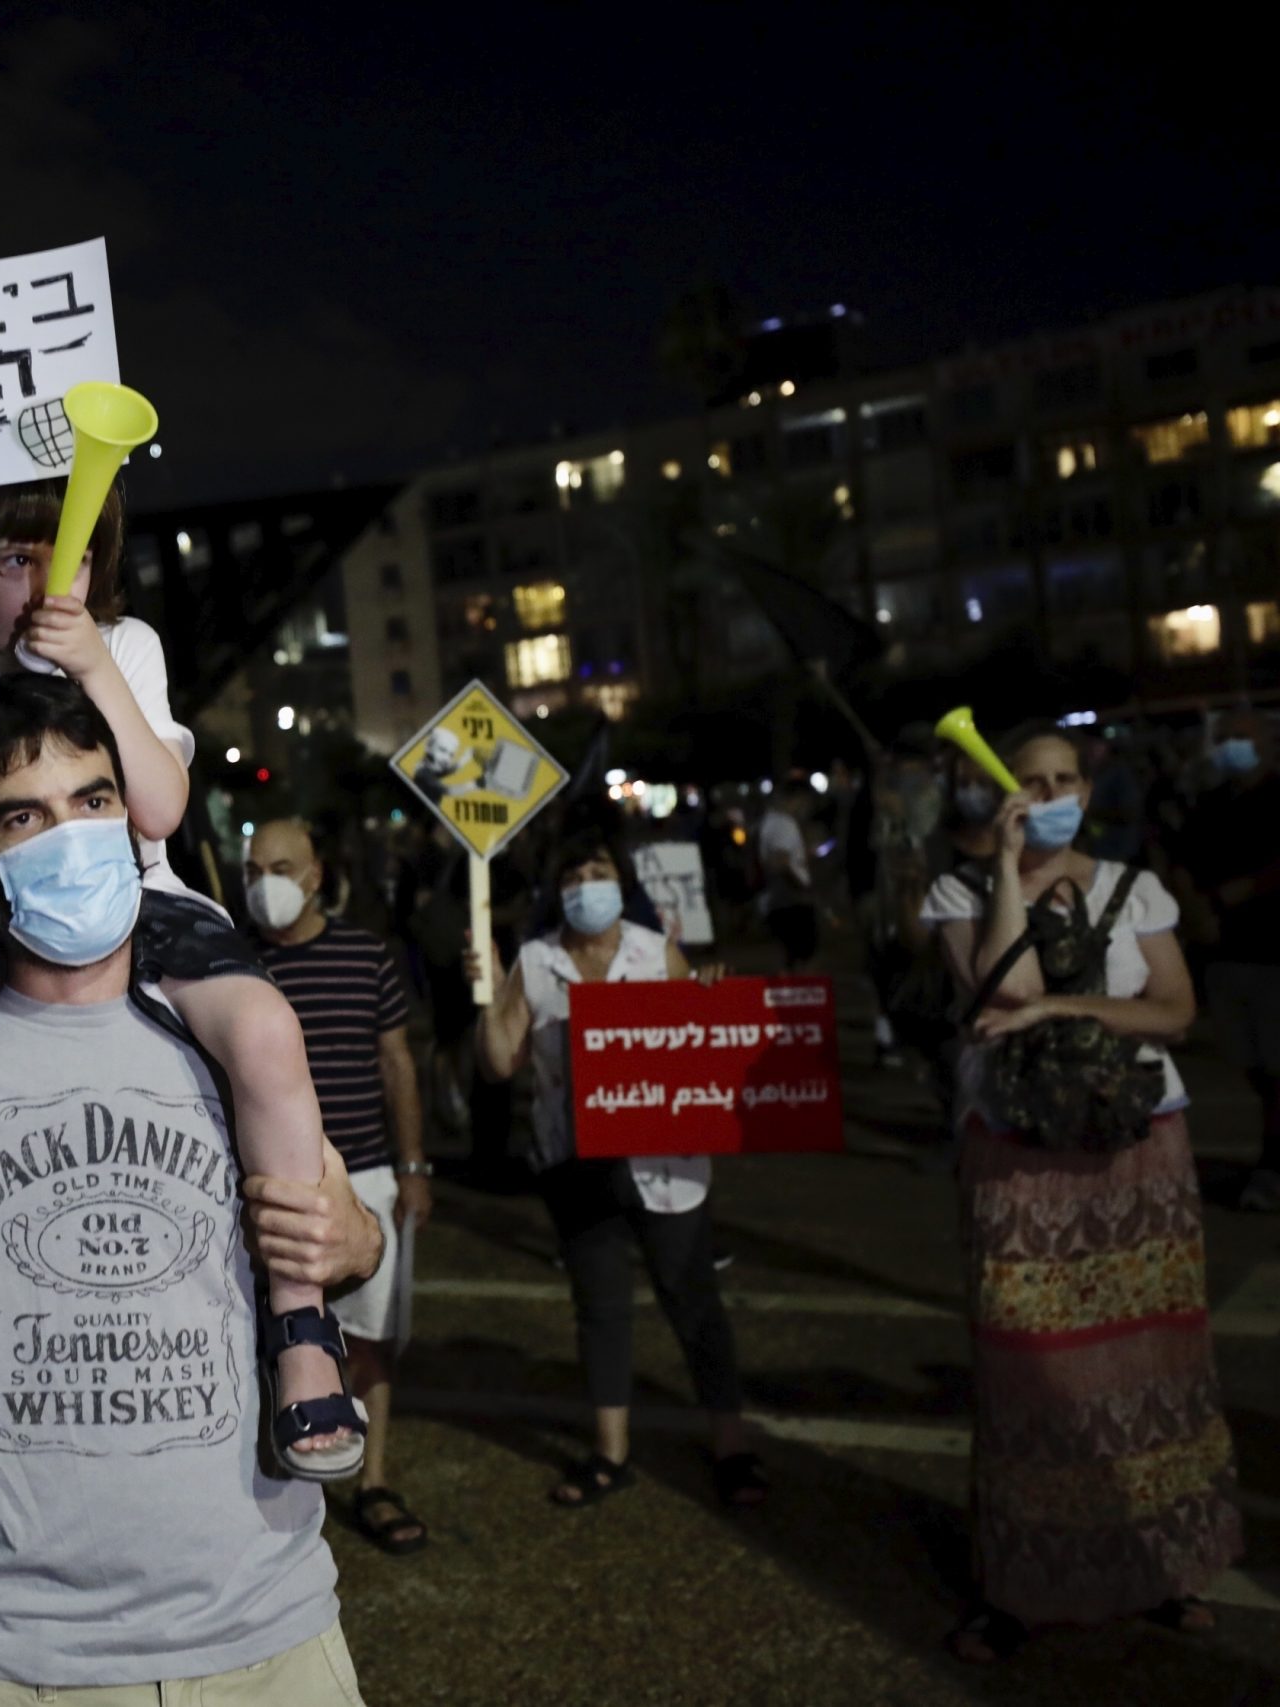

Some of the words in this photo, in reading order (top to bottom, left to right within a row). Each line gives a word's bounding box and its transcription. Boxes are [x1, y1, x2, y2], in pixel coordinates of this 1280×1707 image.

[584, 1022, 705, 1050] לעשירים
[710, 1024, 760, 1047] טוב
[765, 1024, 822, 1045] ביבי
[672, 1081, 734, 1115] يخدم
[53, 1173, 99, 1195] OLD
[110, 1172, 165, 1194] TIME
[82, 1212, 143, 1234] Old
[80, 1261, 147, 1276] BRAND
[73, 1312, 152, 1328] QUALITY
[13, 1312, 210, 1364] Tennessee
[10, 1367, 107, 1385] SOUR
[135, 1361, 214, 1384] MASH
[3, 1383, 219, 1425] WHISKEY
